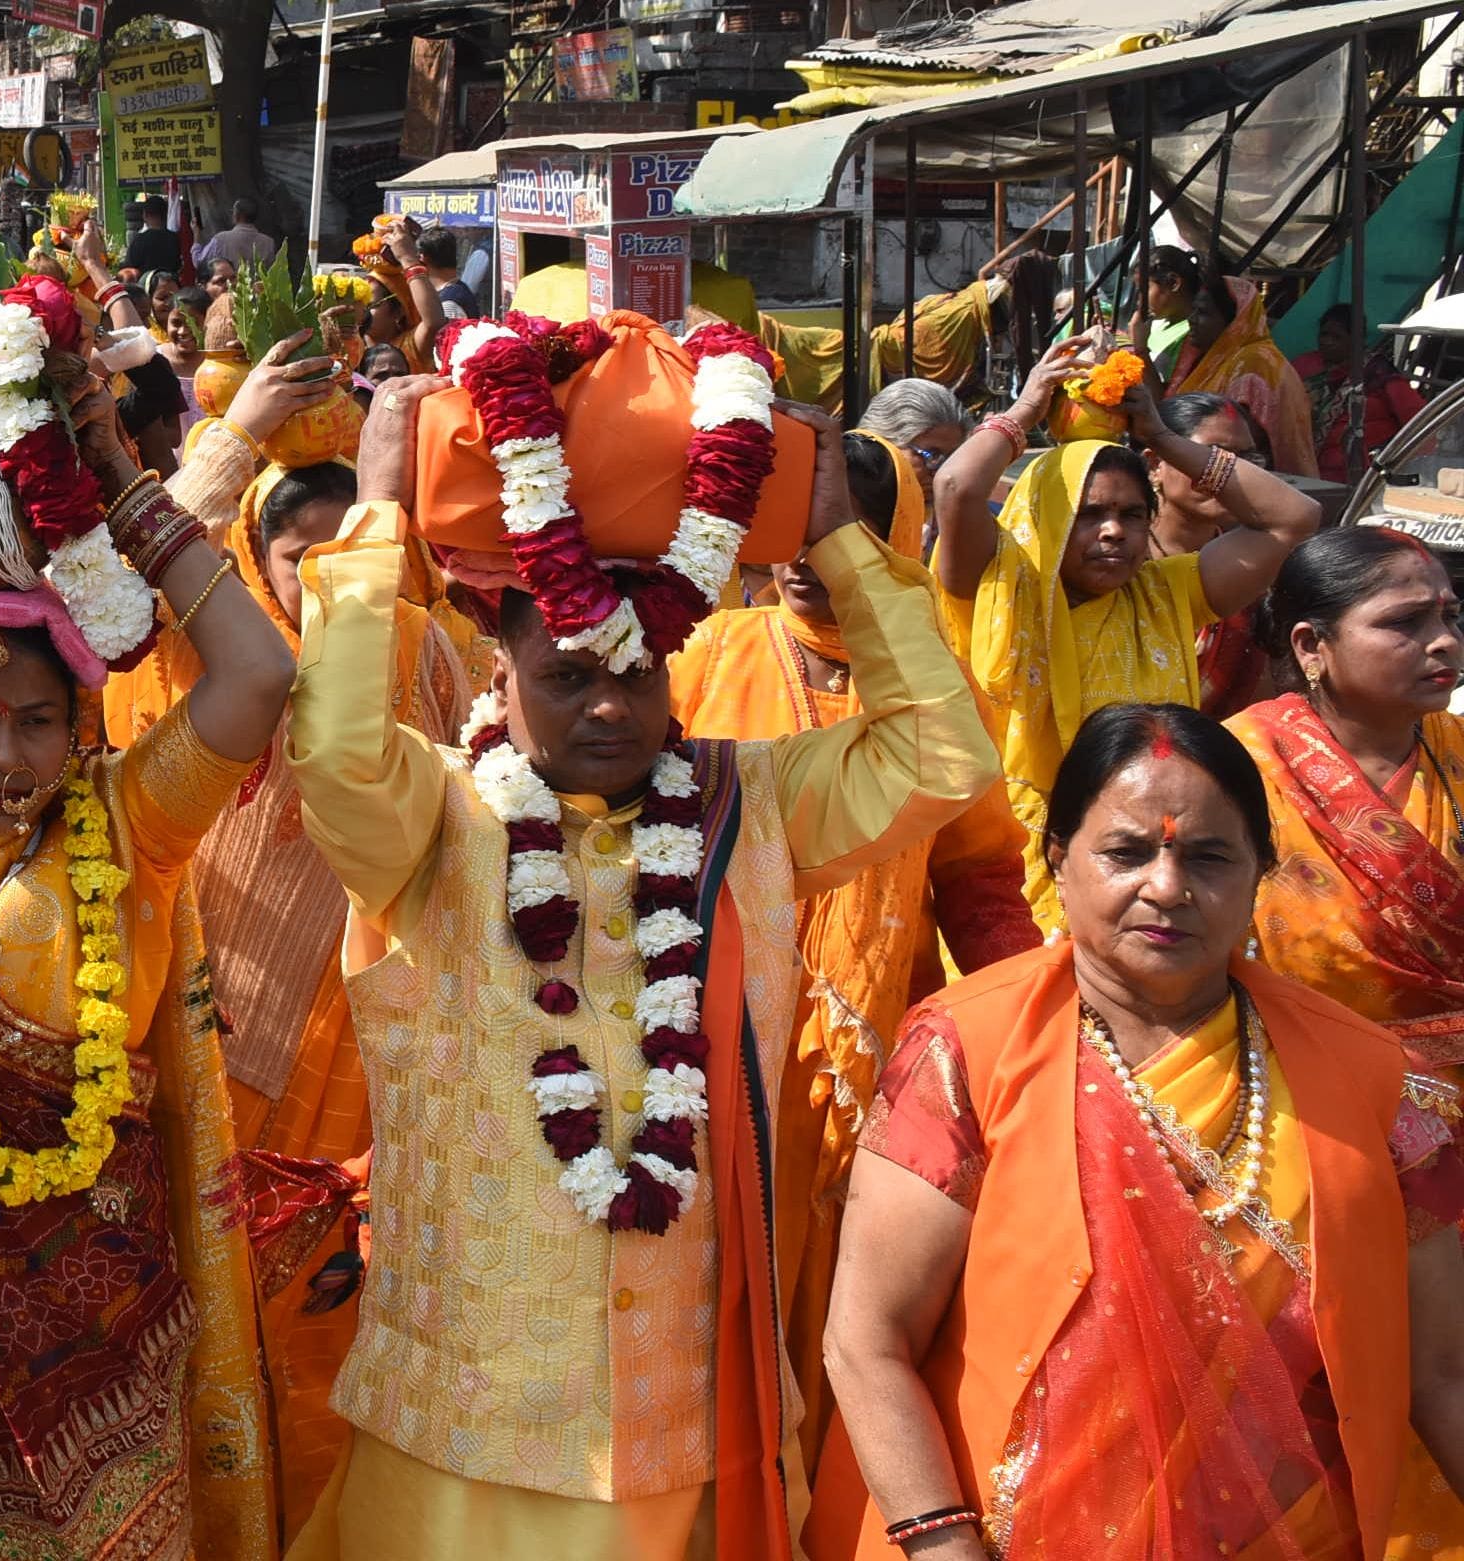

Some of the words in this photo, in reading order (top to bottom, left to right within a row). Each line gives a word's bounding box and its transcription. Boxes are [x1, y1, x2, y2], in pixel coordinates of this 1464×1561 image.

[500, 162, 540, 214] Pizza
[540, 157, 574, 227] Day
[619, 233, 685, 257] Pizza
[636, 264, 658, 272] Pizza
[659, 264, 676, 272] Day
